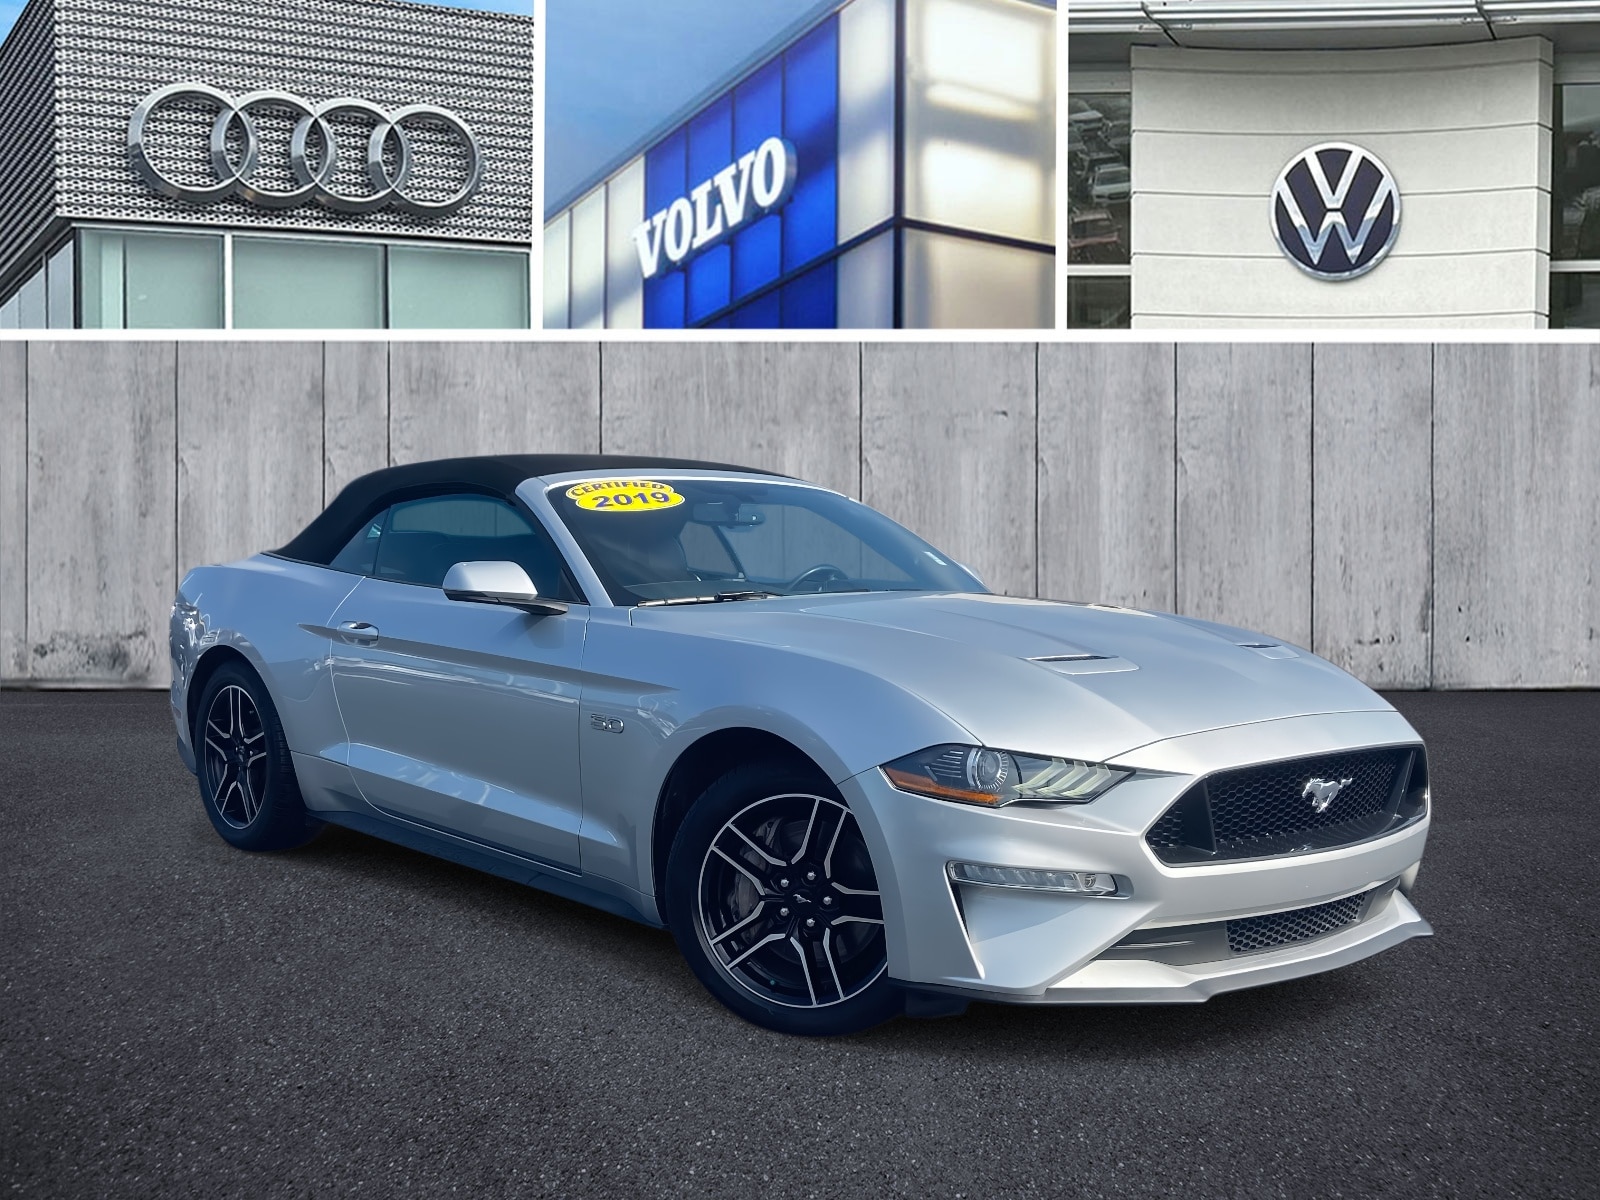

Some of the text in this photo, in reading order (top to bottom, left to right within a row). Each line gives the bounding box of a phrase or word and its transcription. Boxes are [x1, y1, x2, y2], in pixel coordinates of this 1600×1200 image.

[632, 137, 789, 278] VOLVO
[570, 481, 665, 497] CERTIFIED
[592, 491, 670, 508] 2019
